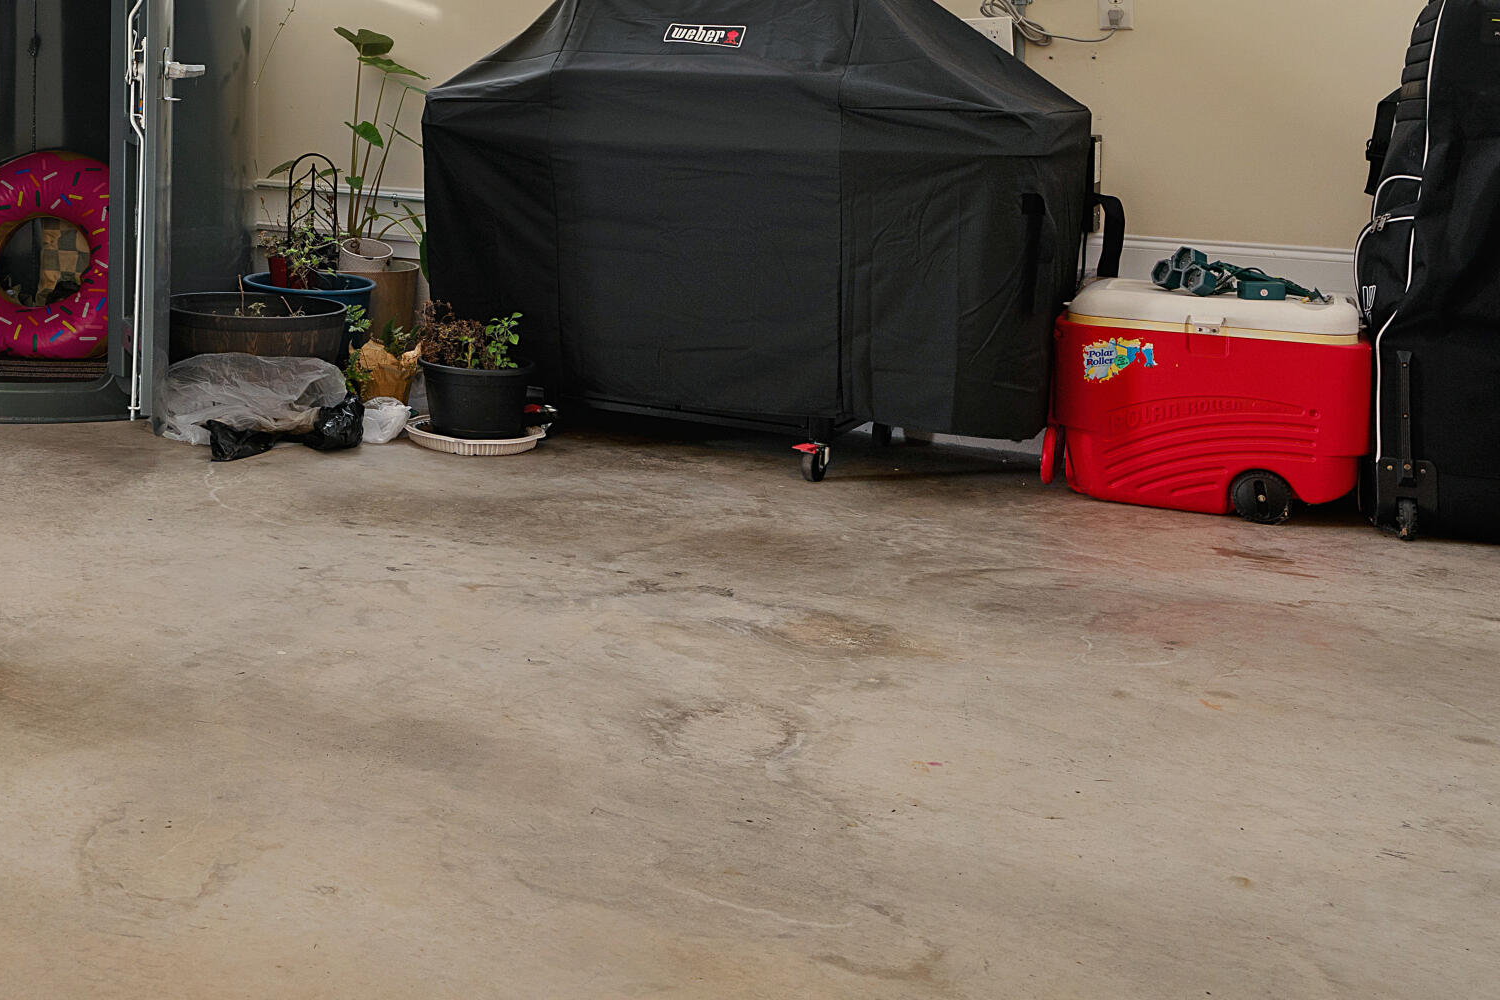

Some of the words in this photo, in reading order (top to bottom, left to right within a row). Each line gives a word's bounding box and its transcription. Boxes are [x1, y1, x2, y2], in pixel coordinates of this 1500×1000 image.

[671, 25, 725, 43] weber
[1089, 349, 1114, 357] Polar
[1086, 357, 1114, 366] Roller
